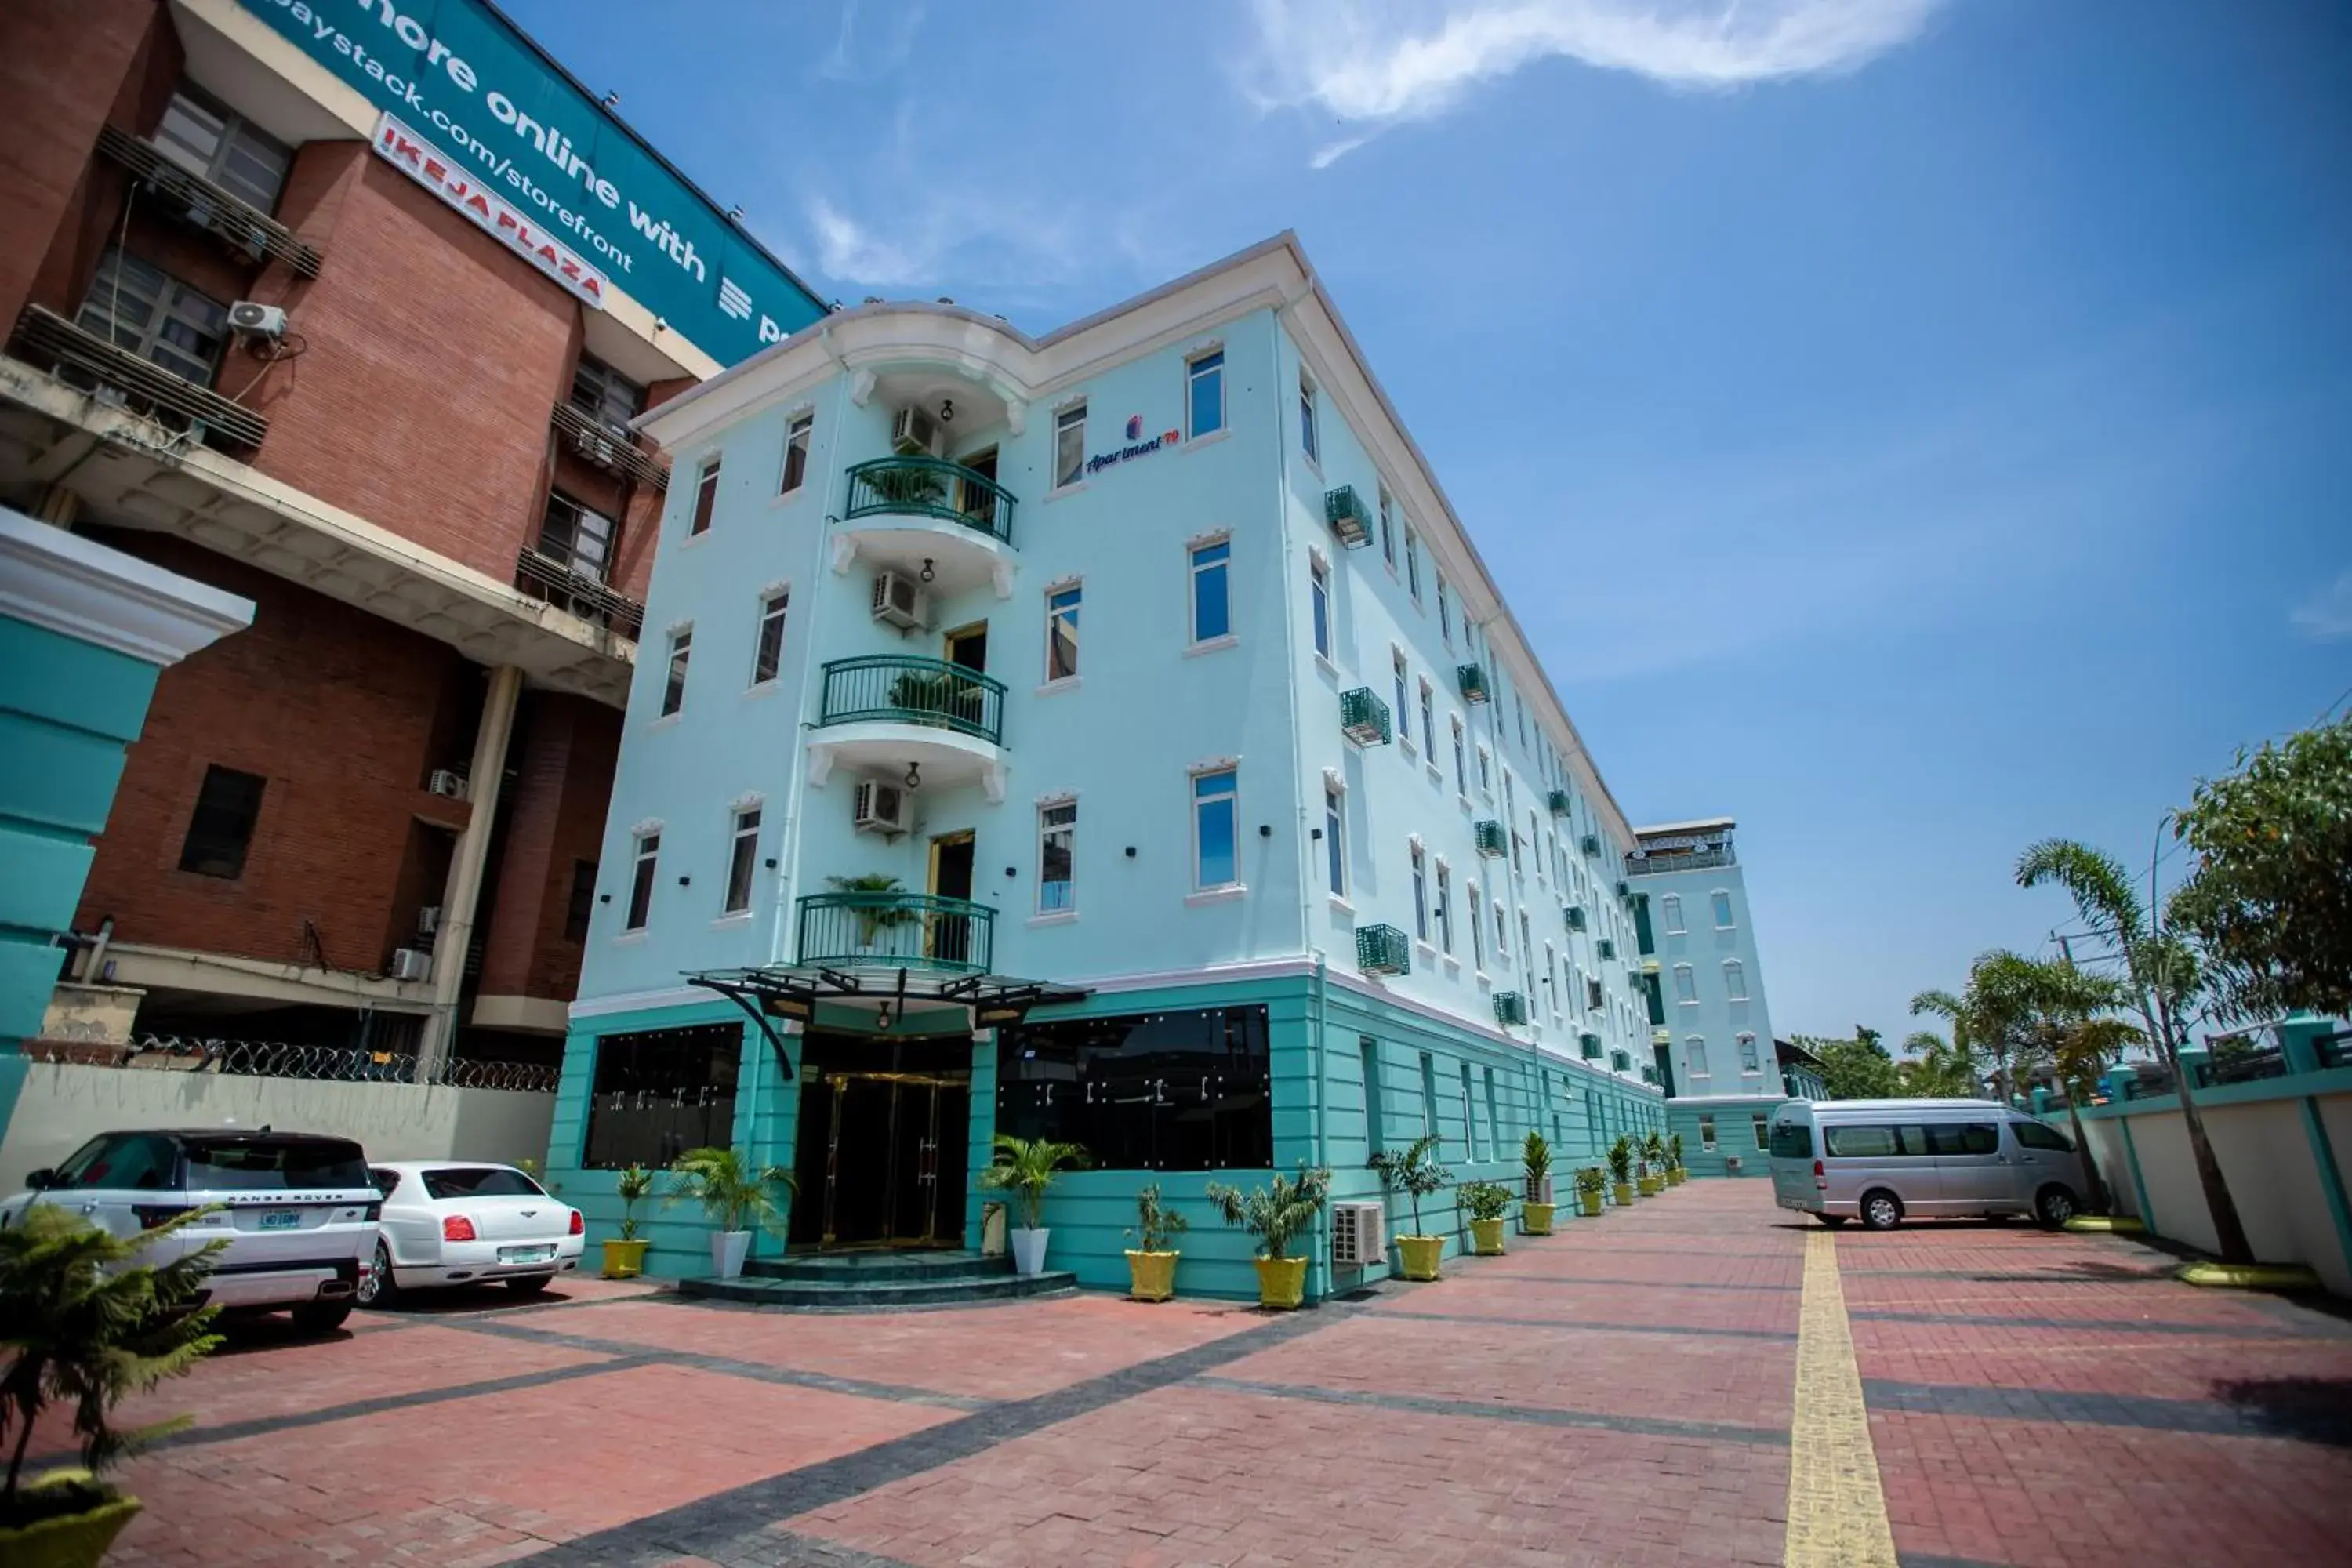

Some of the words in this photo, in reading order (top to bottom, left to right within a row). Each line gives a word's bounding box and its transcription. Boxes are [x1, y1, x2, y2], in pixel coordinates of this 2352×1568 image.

[252, 0, 633, 274] aystack.com/storefront
[384, 127, 490, 218] IKEJA
[497, 211, 601, 298] PLAZA
[487, 91, 620, 209] online
[628, 201, 706, 283] with
